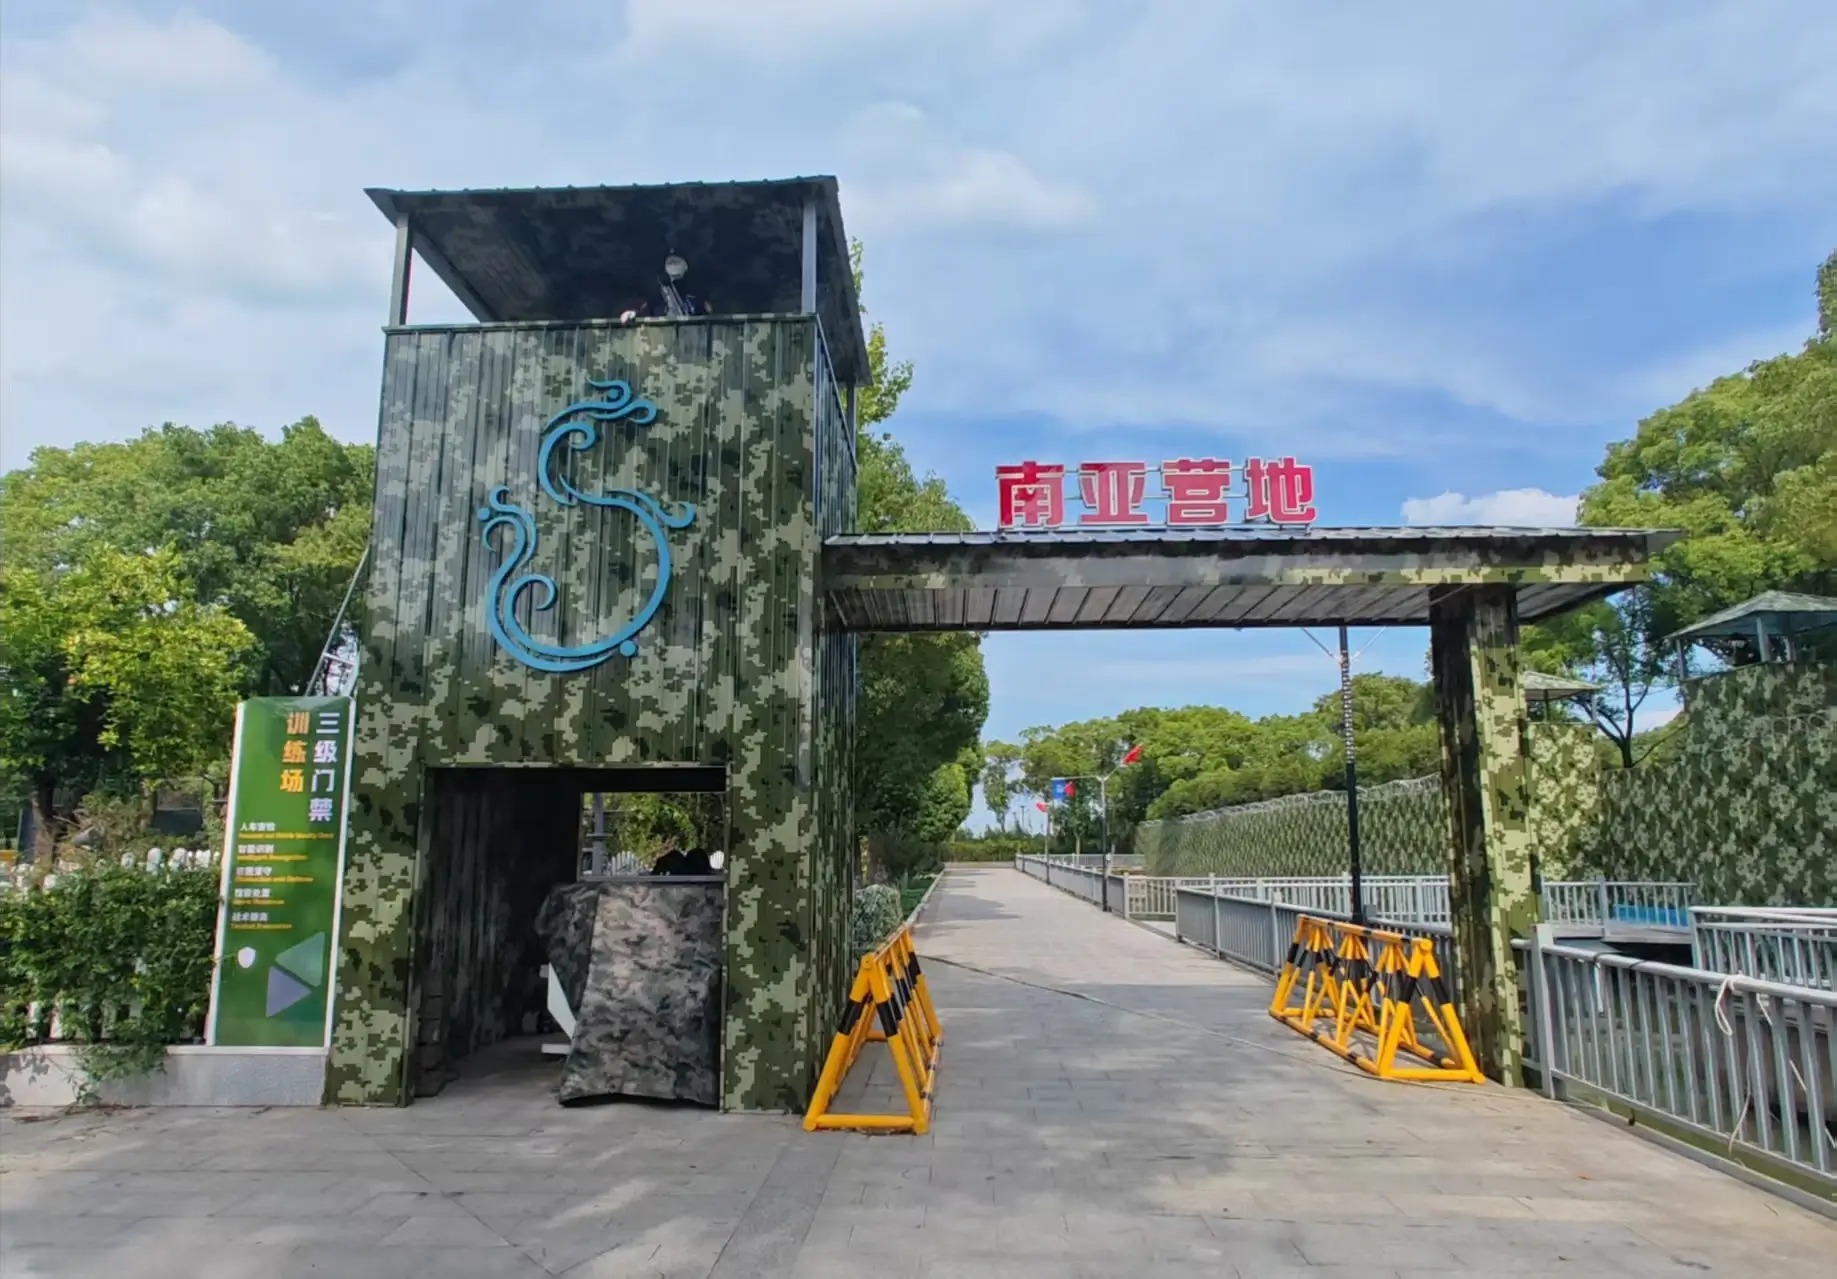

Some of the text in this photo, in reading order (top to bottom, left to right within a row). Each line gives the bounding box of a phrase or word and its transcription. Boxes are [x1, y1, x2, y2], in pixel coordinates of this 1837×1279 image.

[995, 456, 1317, 528] 南亚营地
[280, 711, 310, 792] 训练场
[308, 711, 341, 822] 三级门禁
